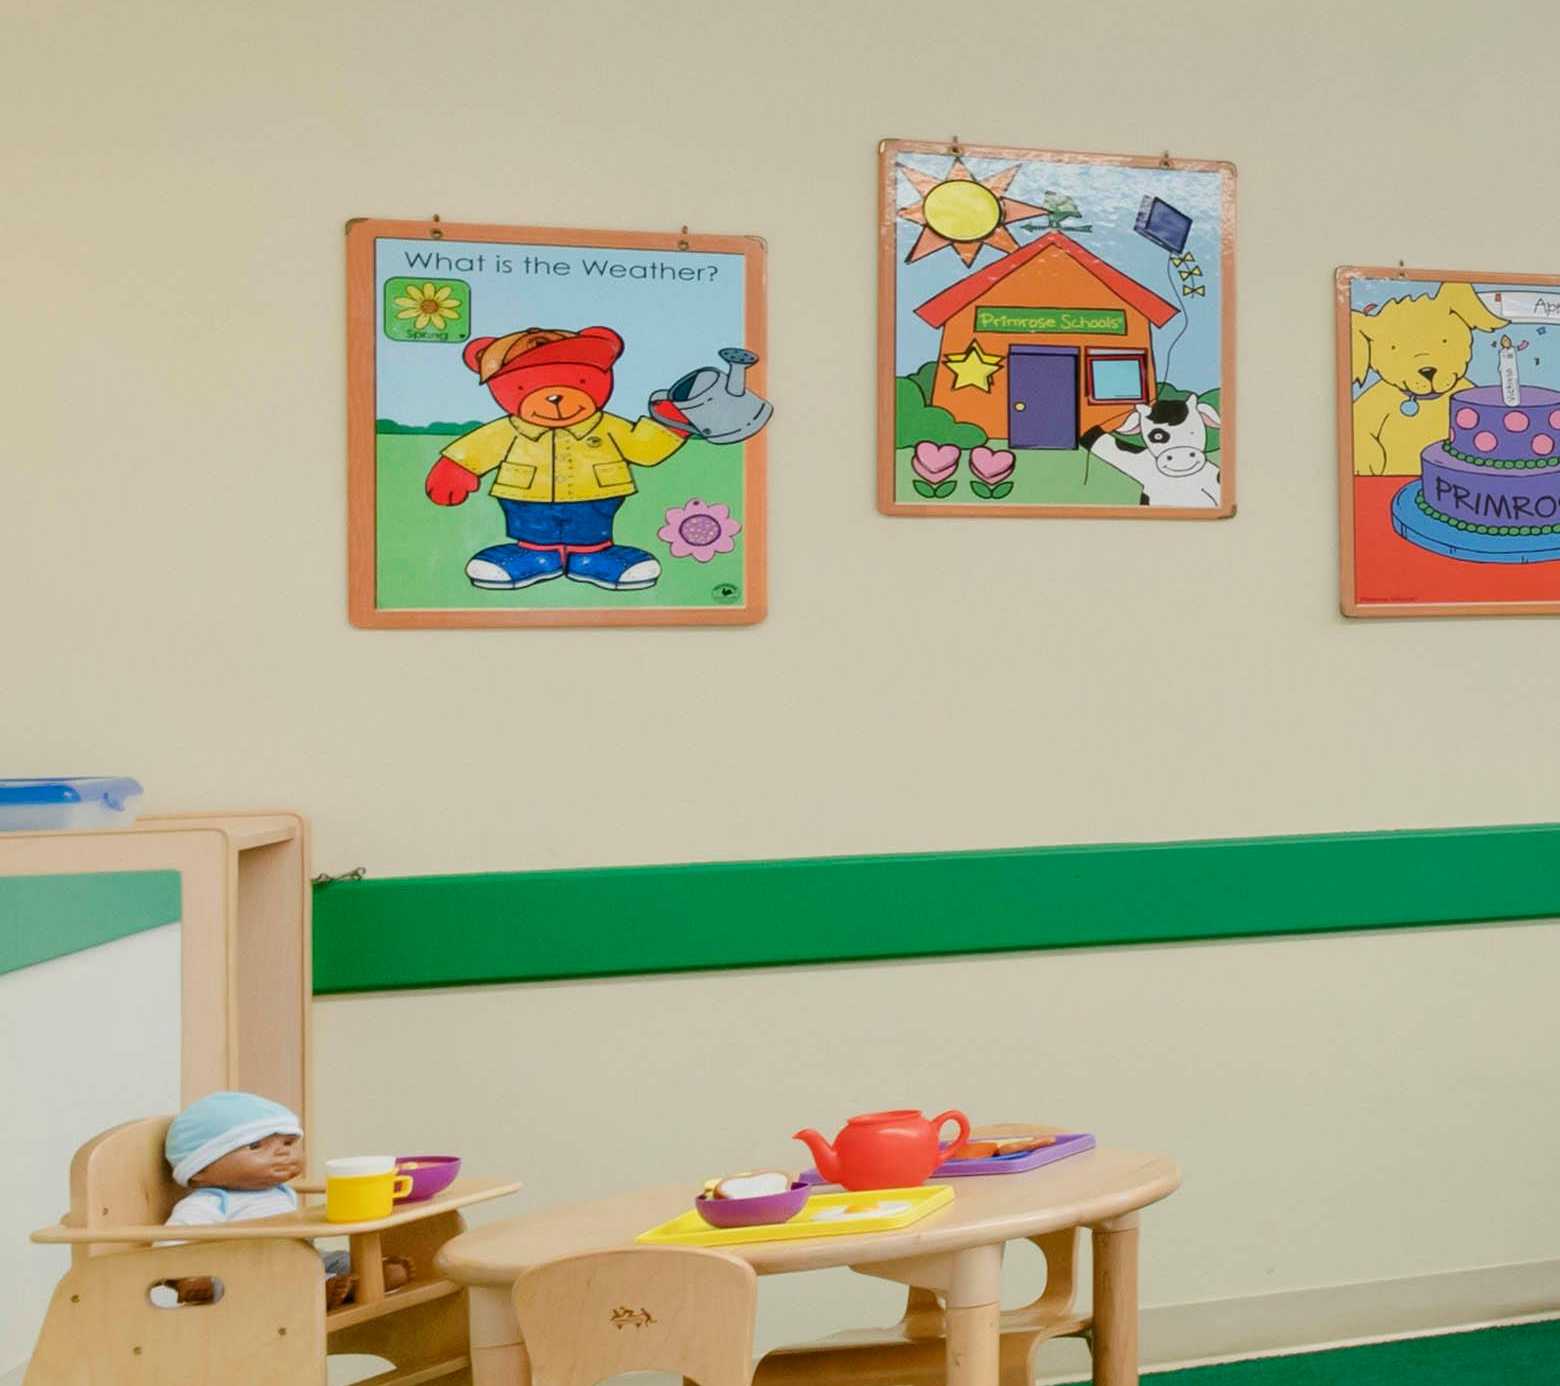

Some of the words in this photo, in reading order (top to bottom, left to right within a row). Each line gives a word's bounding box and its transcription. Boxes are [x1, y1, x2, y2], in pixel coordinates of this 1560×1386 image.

[405, 251, 485, 272] What
[496, 255, 513, 274] is
[524, 256, 571, 276] the
[582, 259, 719, 282] Weather?
[979, 313, 1057, 328] Primrose
[406, 328, 449, 342] Spring
